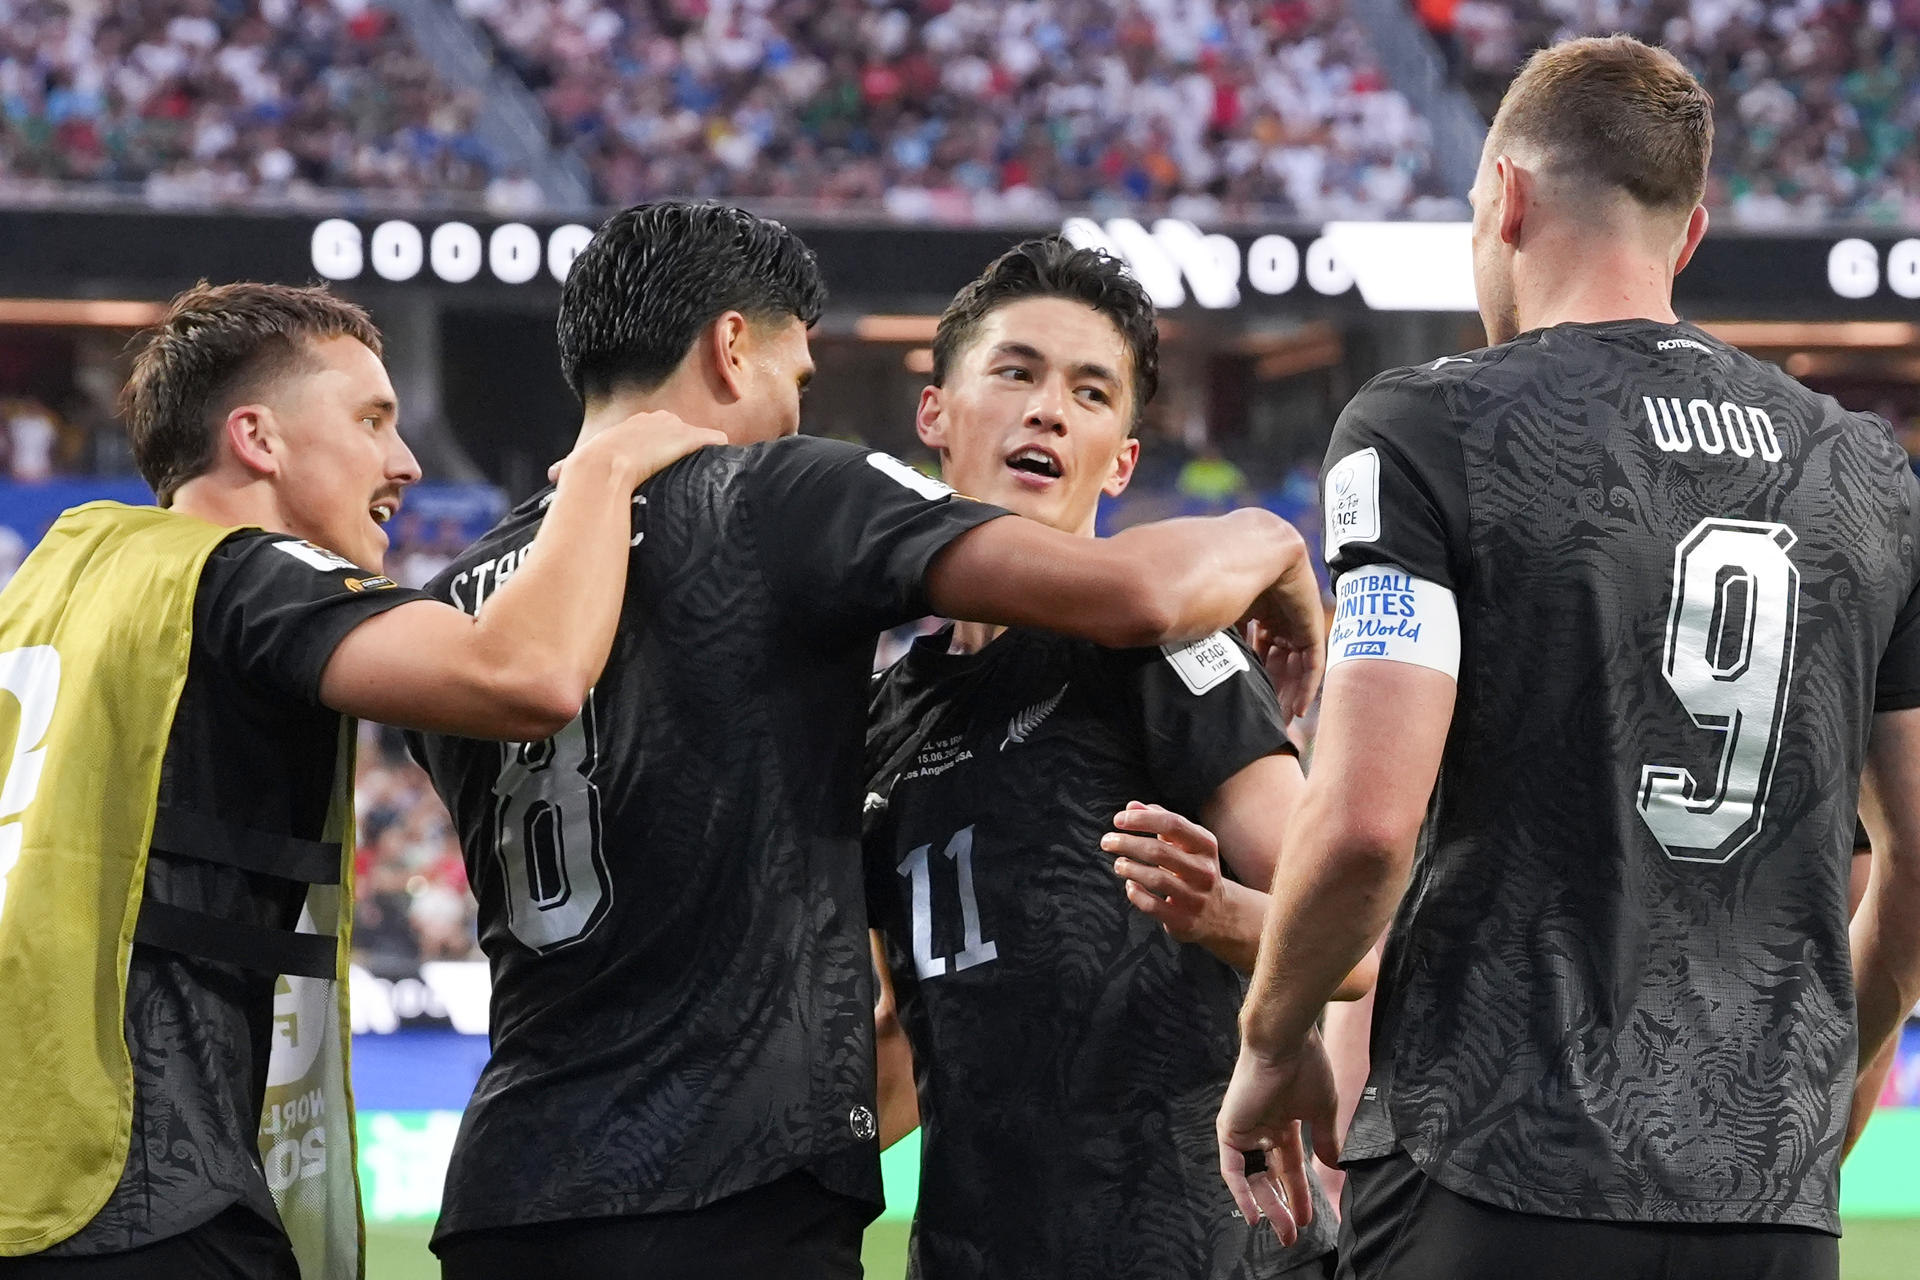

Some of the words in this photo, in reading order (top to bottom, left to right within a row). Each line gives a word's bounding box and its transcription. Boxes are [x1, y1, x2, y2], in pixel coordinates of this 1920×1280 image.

[1642, 396, 1783, 463] WOOD
[1340, 574, 1415, 598] FOOTBALL
[1336, 592, 1415, 622] UNITES
[1332, 623, 1354, 646] the
[1356, 618, 1422, 643] World
[1345, 642, 1384, 656] FIFA
[1636, 517, 1800, 864] 9
[896, 824, 998, 981] 11
